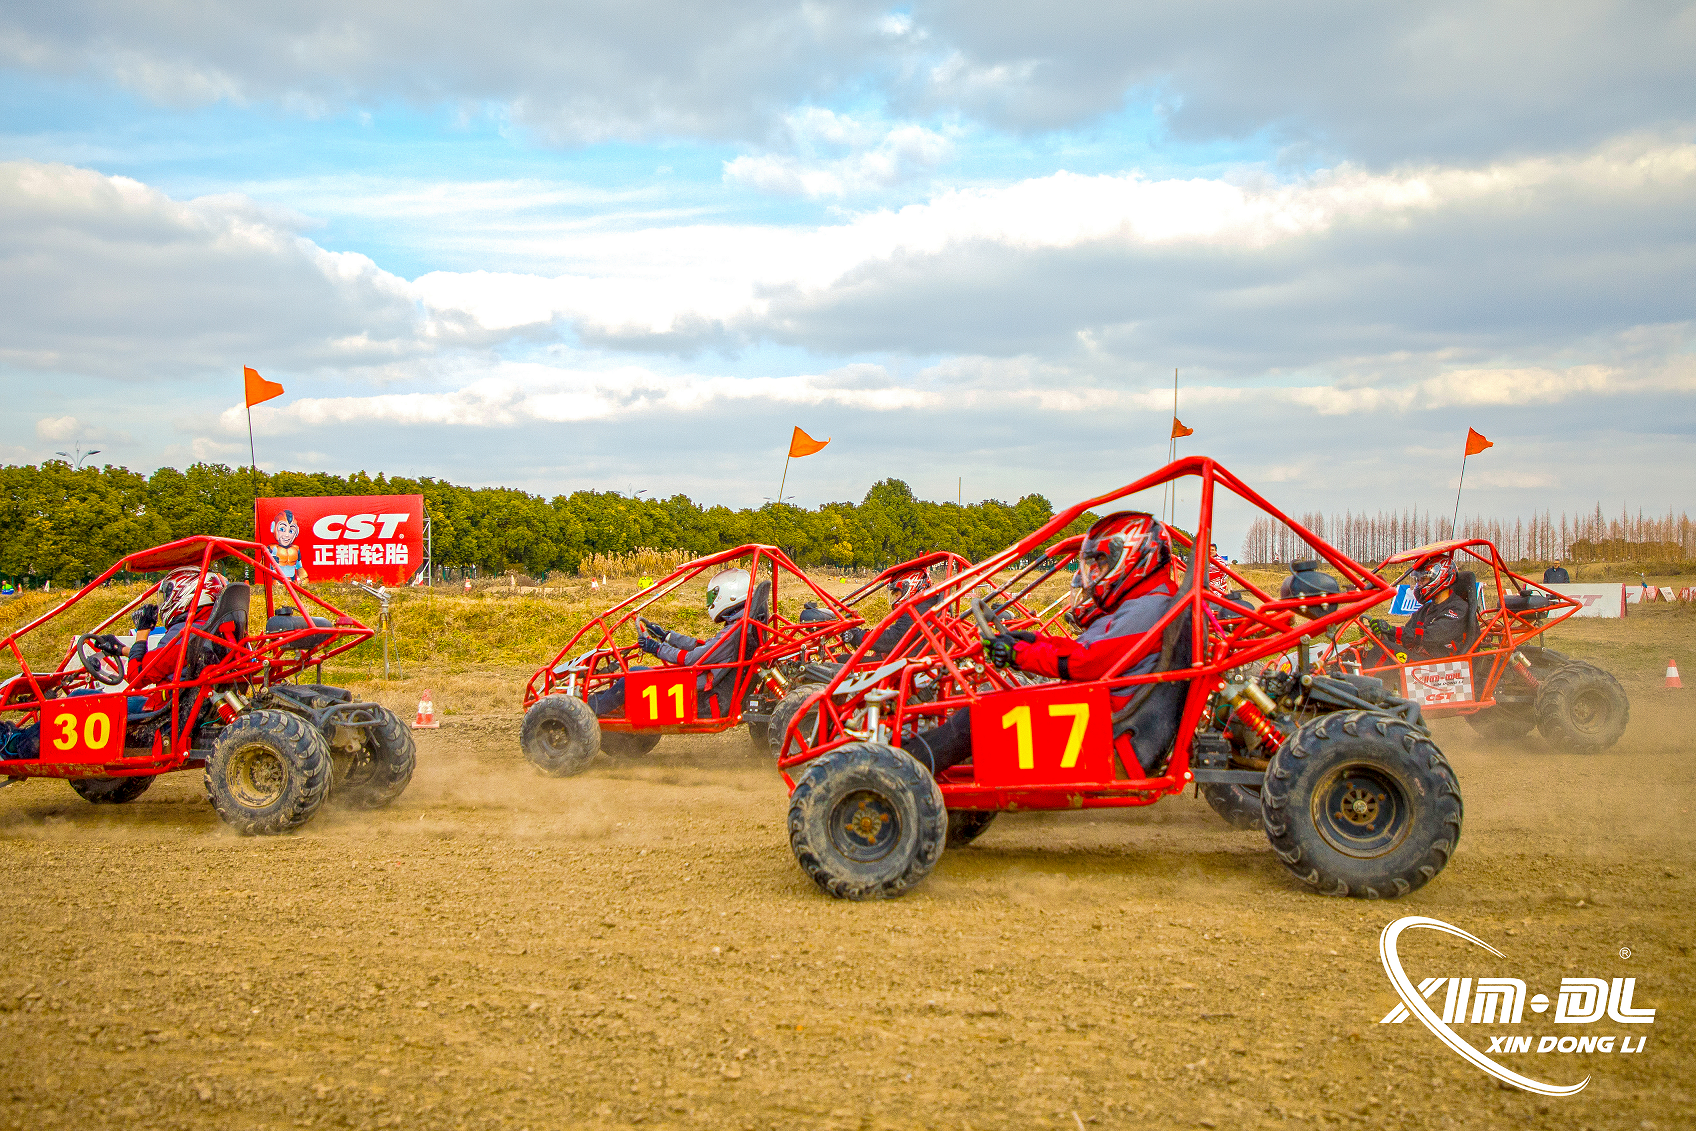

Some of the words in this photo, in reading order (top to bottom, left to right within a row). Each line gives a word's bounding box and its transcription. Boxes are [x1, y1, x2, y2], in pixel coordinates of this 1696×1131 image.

[312, 513, 410, 540] CST
[312, 543, 408, 566] 正新轮胎
[641, 684, 685, 720] 11
[1425, 692, 1454, 702] CST
[53, 712, 110, 750] 30
[1001, 702, 1090, 770] 17
